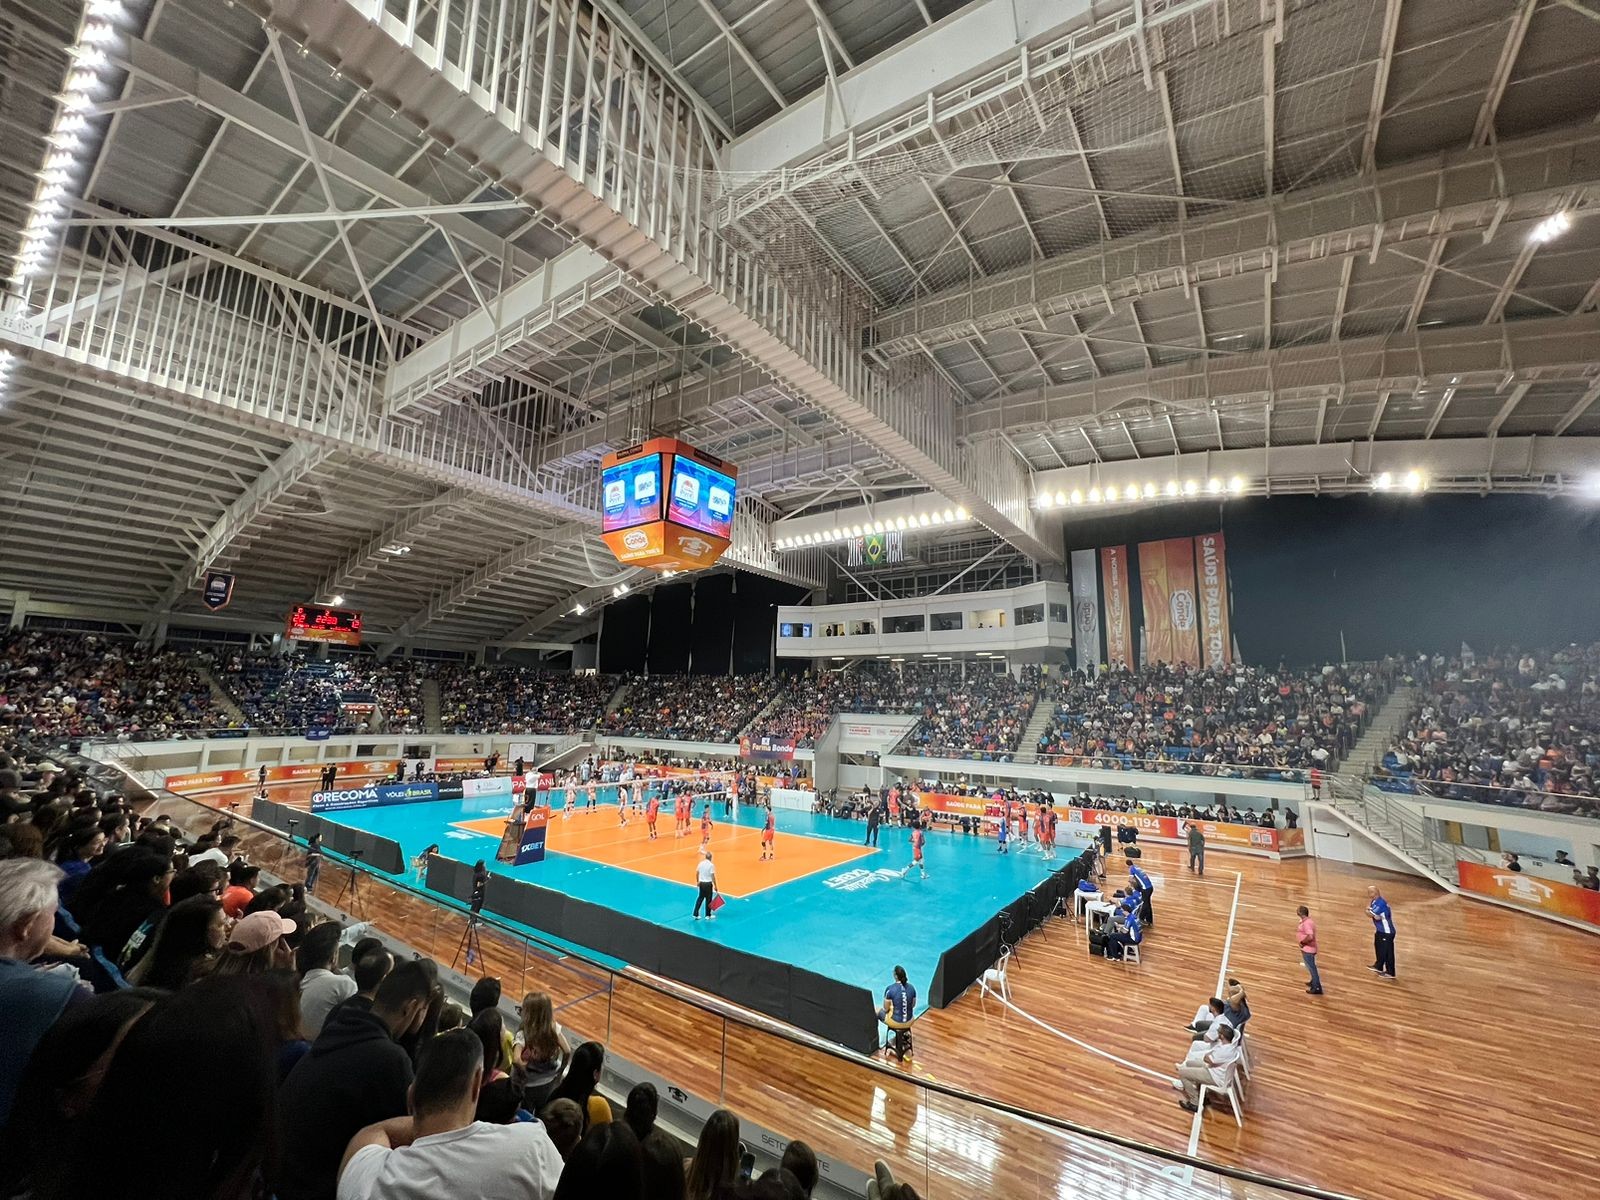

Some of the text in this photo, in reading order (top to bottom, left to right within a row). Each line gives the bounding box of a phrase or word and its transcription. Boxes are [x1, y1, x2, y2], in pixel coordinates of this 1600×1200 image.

[1202, 537, 1219, 585] SAÚDE
[1082, 602, 1091, 632] Conde
[1176, 592, 1187, 628] Conde
[1206, 588, 1220, 628] PARA
[752, 743, 793, 752] Farma Bonde
[324, 789, 378, 802] RECOMA
[1095, 813, 1160, 828] 4000-1194
[521, 842, 544, 852] 1XBET
